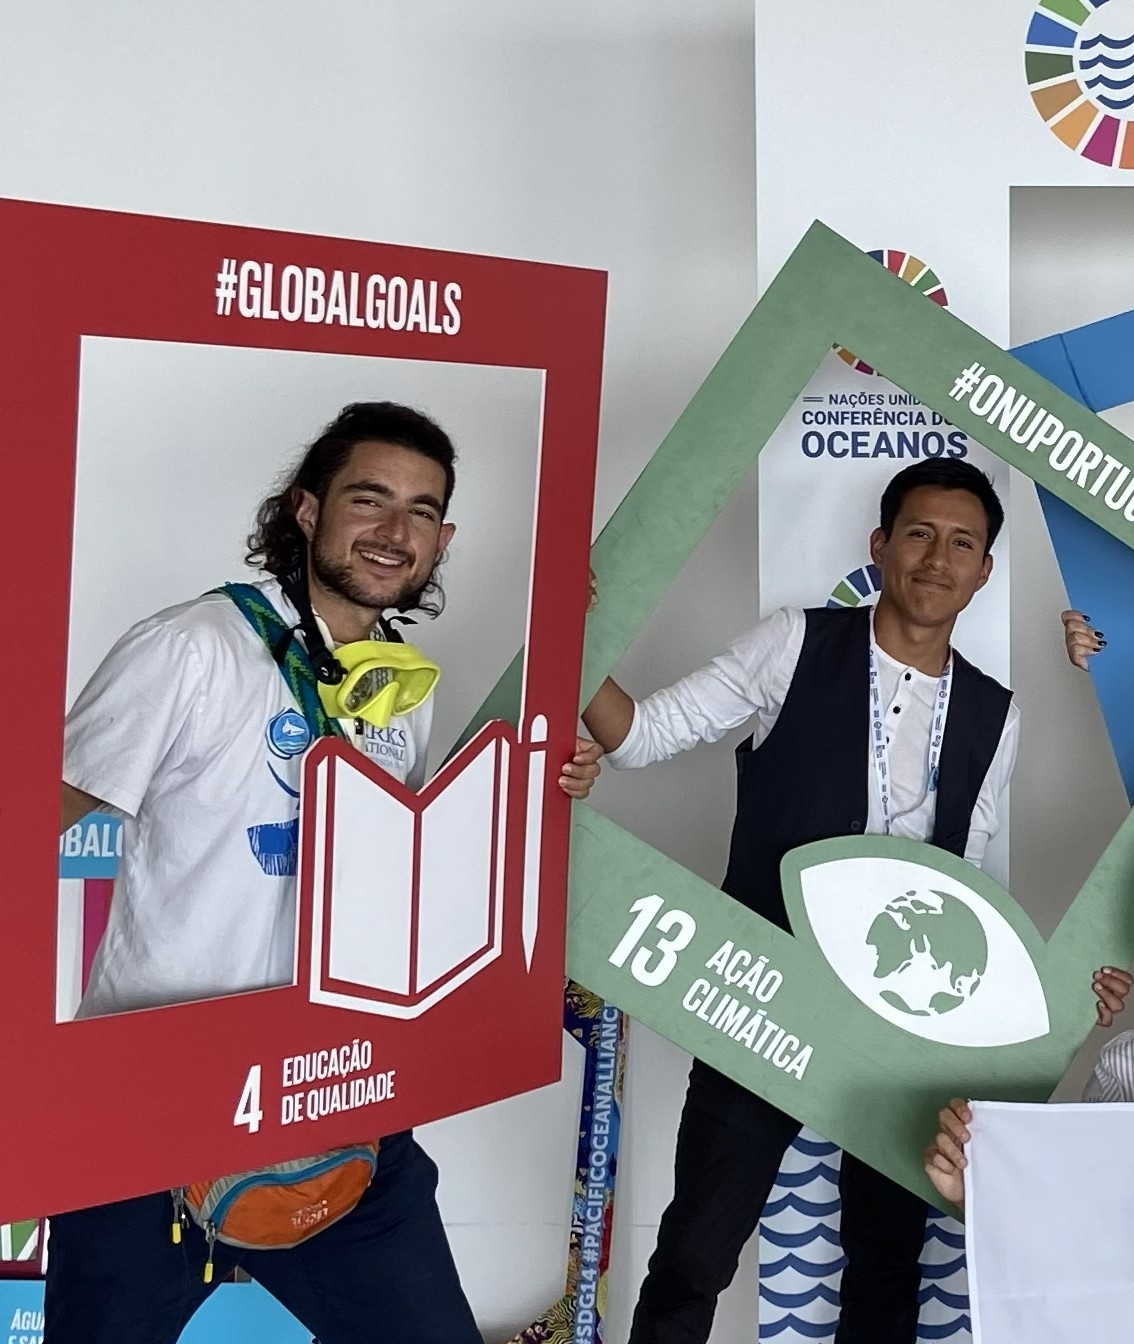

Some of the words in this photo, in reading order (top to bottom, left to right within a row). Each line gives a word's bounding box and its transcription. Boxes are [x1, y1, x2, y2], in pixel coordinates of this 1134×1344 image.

[214, 258, 463, 336] #GLOBALGOALS
[801, 407, 927, 426] CONFERÊNCIA
[828, 391, 885, 408] NAÇÕES
[888, 393, 925, 406] UNID
[801, 430, 969, 459] OCEANOS
[59, 822, 124, 858] BAL
[607, 893, 700, 988] 13
[705, 939, 784, 1004] AÇÃO
[682, 977, 815, 1082] CLIMÁTICA
[281, 1039, 373, 1087] EDUCAÇÃO
[232, 1064, 263, 1134] 4
[280, 1095, 305, 1126] DE
[307, 1069, 396, 1121] QUALIDADE
[582, 1000, 619, 1263] #PACIFICOCEANALLIANC
